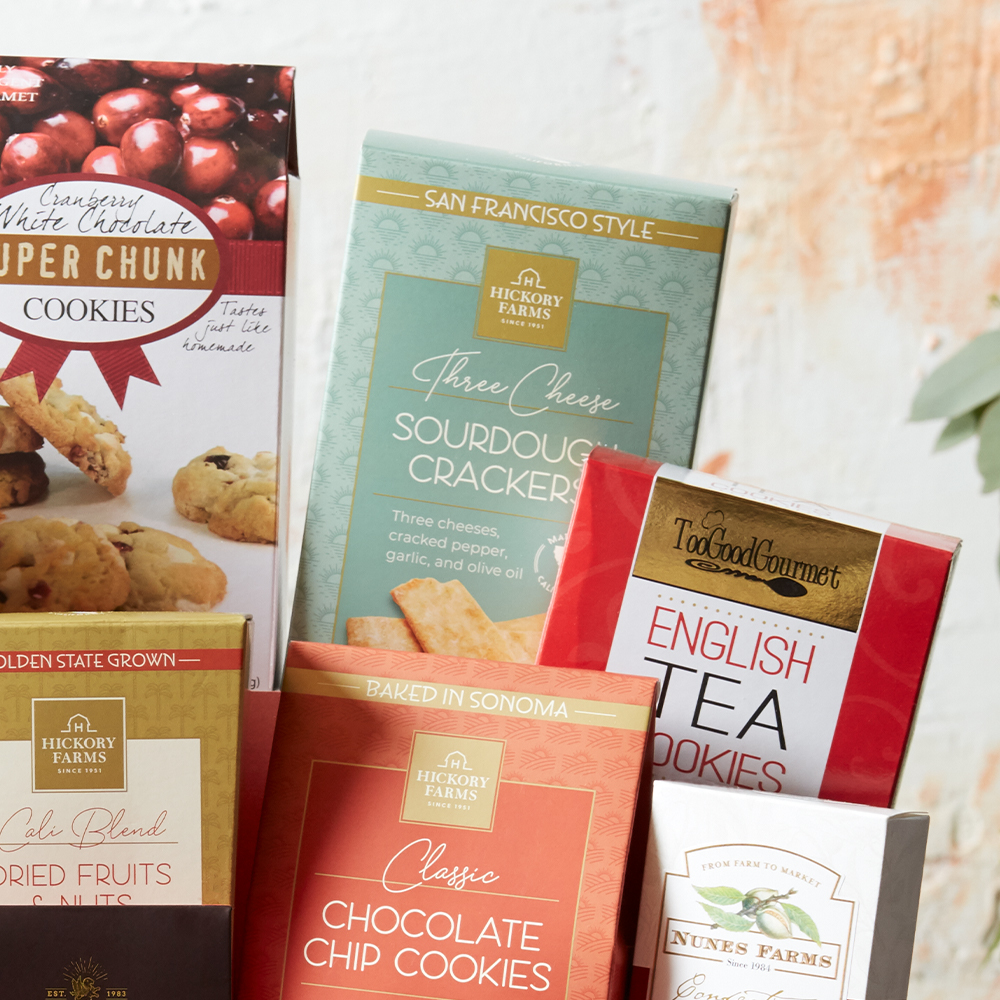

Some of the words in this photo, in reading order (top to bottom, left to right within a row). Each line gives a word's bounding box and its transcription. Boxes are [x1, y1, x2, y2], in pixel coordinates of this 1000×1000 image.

[39, 182, 144, 220] Cranberry
[425, 189, 468, 213] SAN
[471, 196, 589, 231] FRANCISCO
[592, 214, 656, 240] STYLE
[77, 205, 200, 236] Chocolate
[95, 245, 207, 282] CHUNK
[23, 297, 156, 324] COOKIES
[220, 300, 268, 317] Tastes
[489, 285, 564, 309] HICKORY
[497, 301, 551, 322] FARMS
[195, 320, 235, 341] just
[241, 318, 272, 334] like
[501, 317, 526, 328] SINCE
[527, 321, 546, 330] 1951
[183, 338, 257, 353] homemade
[412, 348, 509, 402] Three
[508, 363, 621, 417] Cheese
[392, 509, 434, 530] Three
[437, 517, 500, 539] cheeses,
[389, 531, 447, 552] cracked
[451, 541, 509, 562] pepper,
[673, 518, 842, 590] TooGoodGourmet
[385, 549, 431, 569] garlic,
[434, 555, 464, 571] and
[467, 559, 503, 577] olive
[505, 567, 523, 580] oil
[647, 606, 816, 684] ENGLISH
[55, 653, 104, 669] STATE
[107, 653, 176, 668] GROWN
[366, 680, 438, 704] BAKED
[442, 688, 464, 707] IN
[469, 691, 569, 719] SONOMA
[644, 657, 787, 751] TEA
[41, 736, 116, 751] HICKORY
[52, 751, 107, 765] FARMS
[416, 770, 490, 789] HICKORY
[424, 785, 478, 802] FARMS
[68, 806, 168, 850] Blend
[77, 863, 172, 886] FRUITS
[382, 838, 500, 893] Classic
[702, 860, 730, 871] FROM
[734, 860, 760, 869] FARM
[764, 862, 778, 871] TO
[781, 866, 822, 889] MARKET
[322, 900, 544, 952] CHOCOLATE
[670, 929, 748, 956] NUNES
[757, 943, 833, 969] FARMS
[303, 937, 381, 972] CHIP
[394, 948, 552, 992] COOKIES
[726, 958, 748, 970] Since
[750, 962, 772, 972] 1984
[47, 989, 67, 998] EST.
[106, 989, 127, 998] 1983
